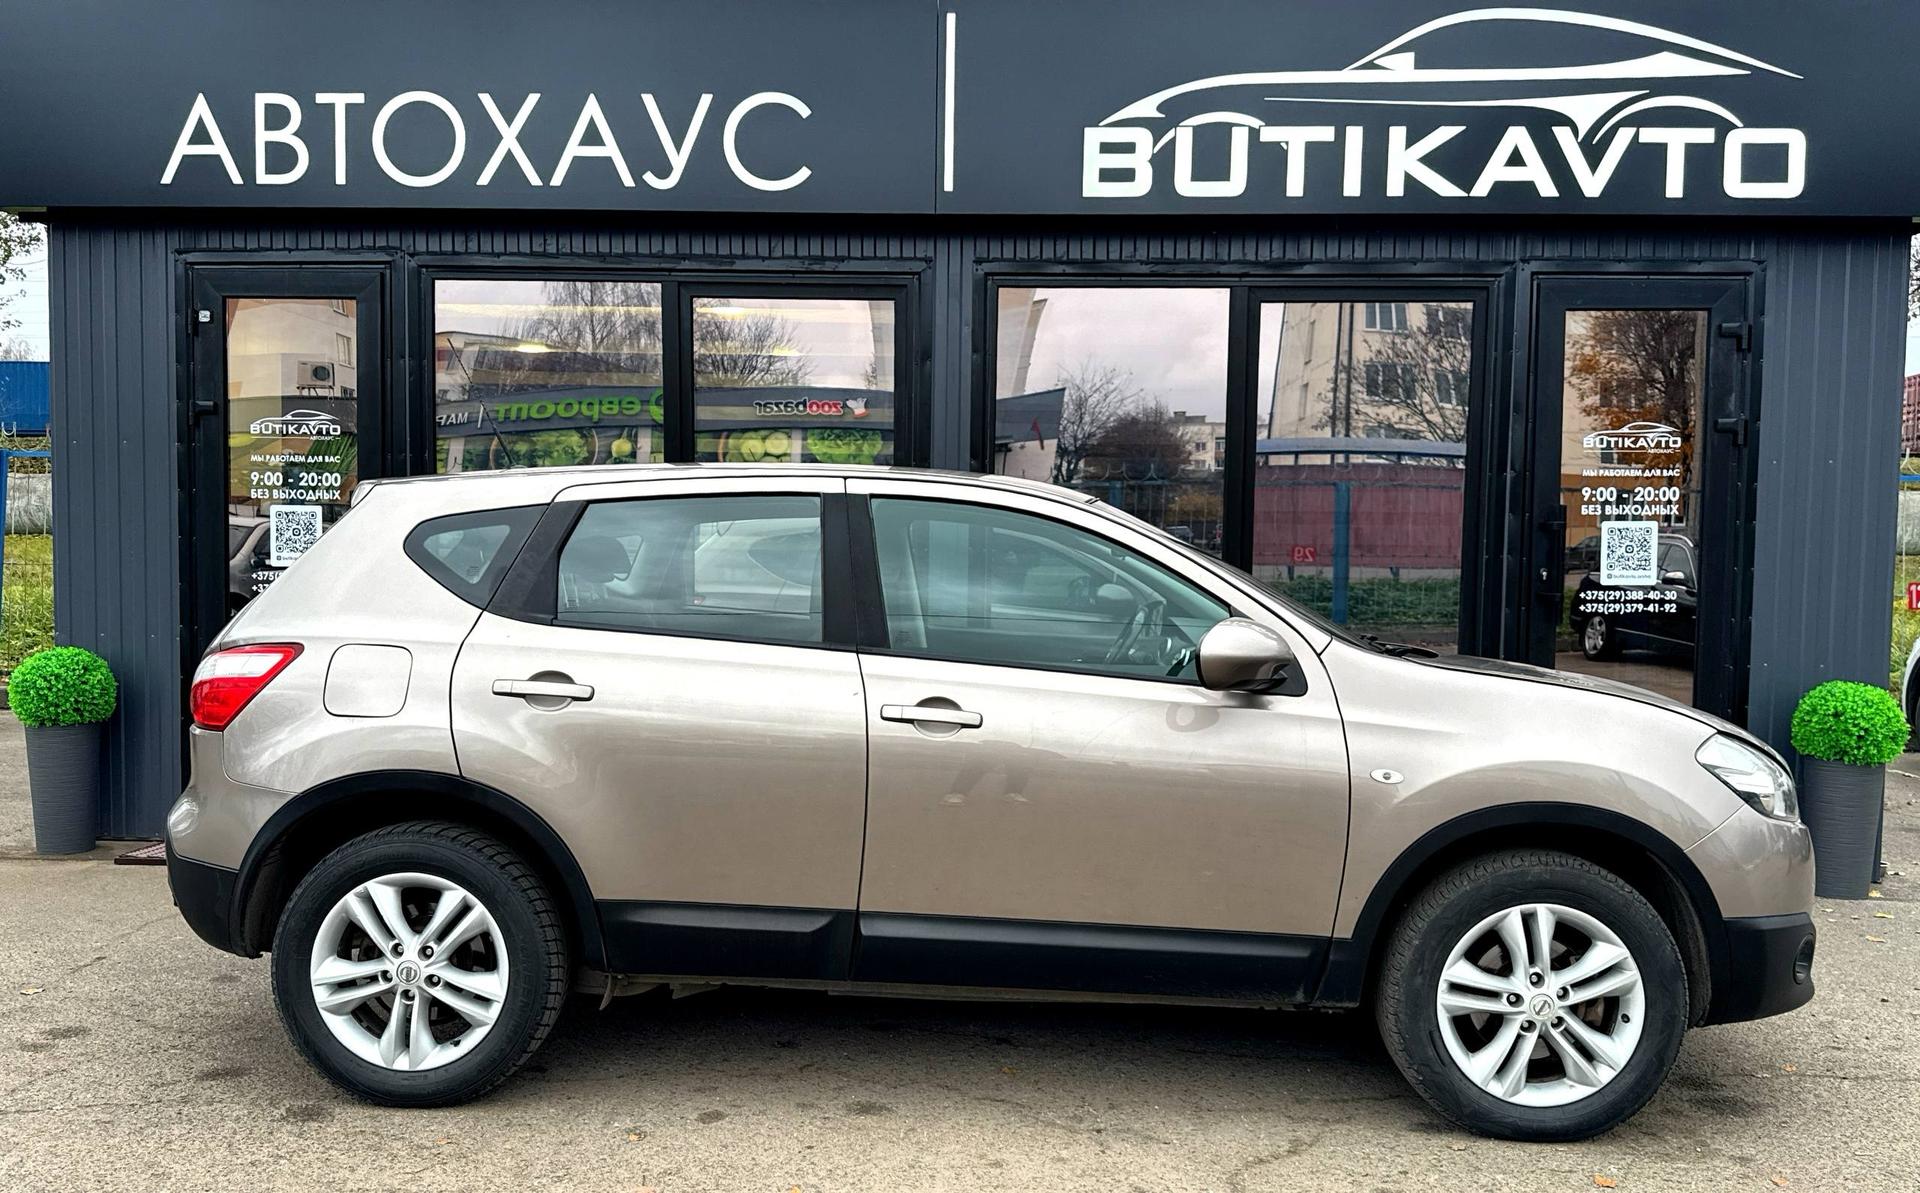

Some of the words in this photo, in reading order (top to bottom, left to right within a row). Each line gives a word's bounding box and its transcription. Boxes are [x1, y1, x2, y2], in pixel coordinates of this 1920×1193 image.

[160, 91, 812, 191] АВТОХАУС
[1083, 126, 1806, 198] BUTIKAVTO
[250, 424, 341, 435] BUTIKAVTO
[1583, 437, 1682, 448] BUTIKAVTO
[265, 455, 305, 463] РАБОТАЕМ
[250, 471, 283, 486] 9:00
[298, 472, 341, 487] 20:00
[1582, 469, 1597, 477] МЫ
[1599, 469, 1642, 477] РАБОТАЕМ
[1643, 469, 1661, 478] ДЛЯ
[1662, 469, 1680, 477] ВАС
[250, 488, 270, 499] БЕЗ
[272, 489, 341, 501] ВЫХОДНЫХ
[1581, 486, 1617, 502] 9:00
[1633, 486, 1680, 502] 20:00
[1581, 504, 1602, 515] БЕЗ
[1604, 504, 1679, 516] ВЫХОДНЫХ
[1579, 590, 1678, 602] +375(29)388-40-30
[1910, 584, 1920, 608] 1
[1579, 603, 1678, 615] +375(29)379-41-92
